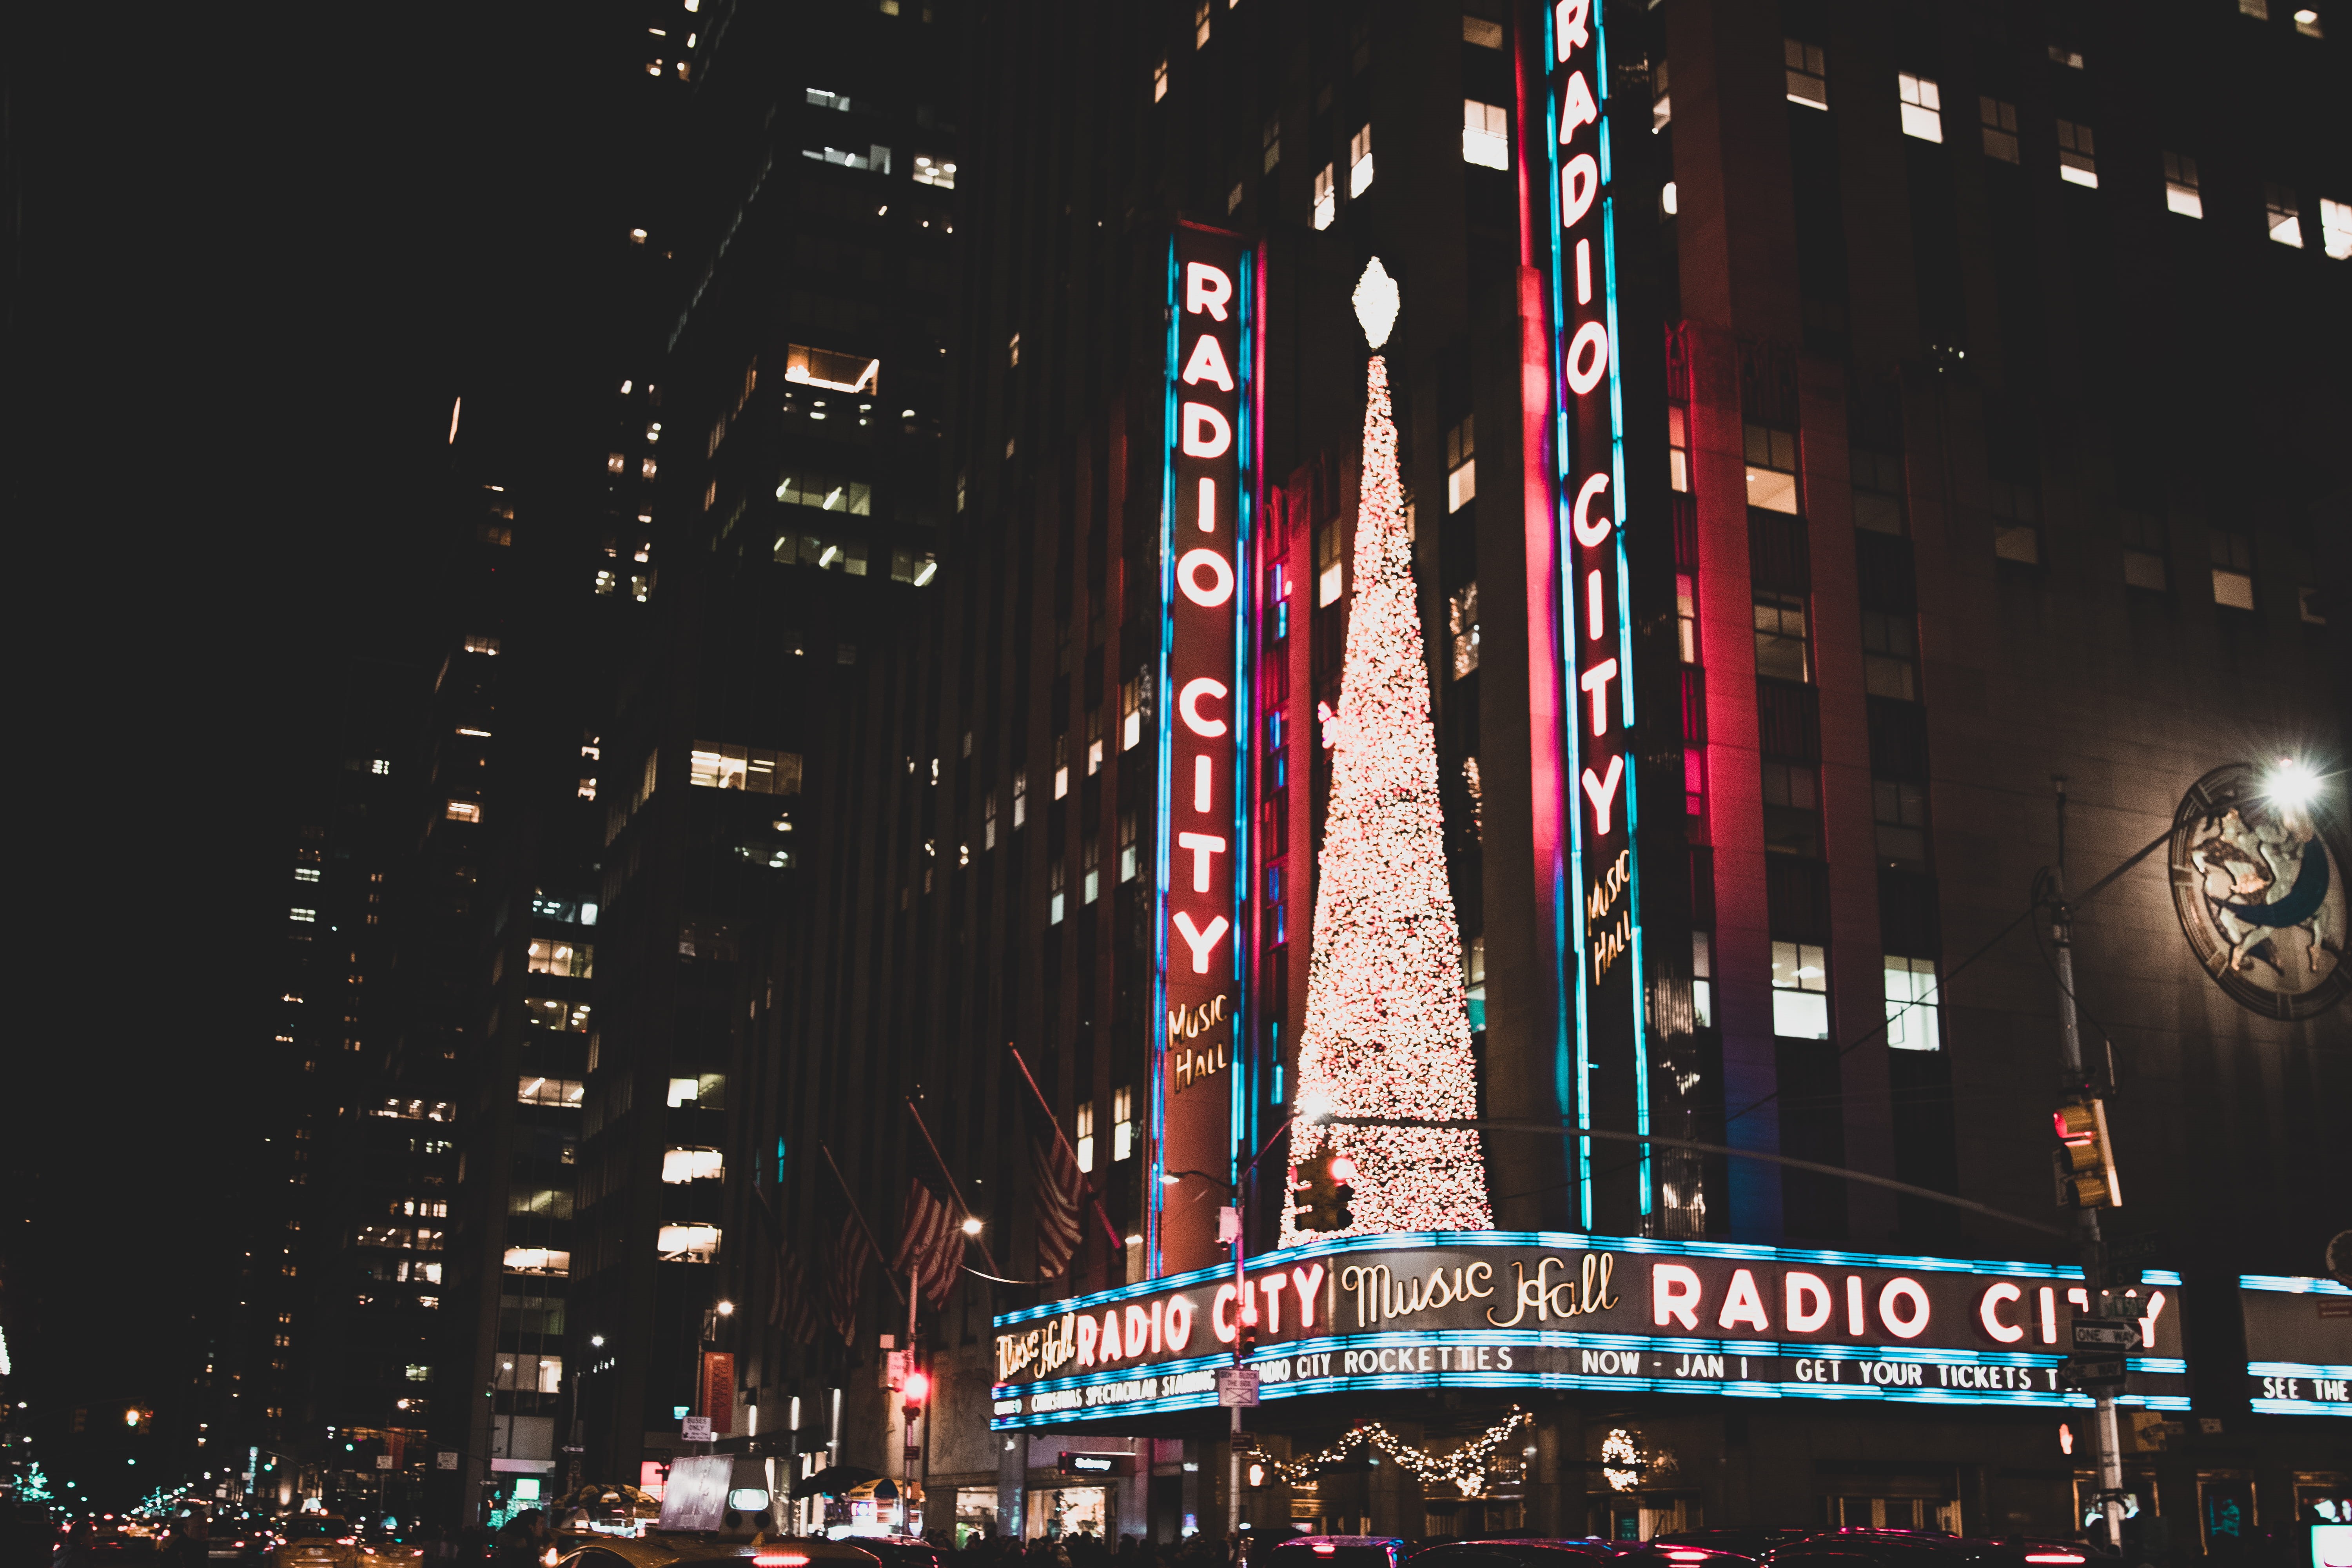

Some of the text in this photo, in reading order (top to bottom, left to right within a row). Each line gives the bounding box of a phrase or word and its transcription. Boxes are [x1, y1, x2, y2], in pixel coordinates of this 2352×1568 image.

[1555, 0, 1608, 394] RADIO
[1176, 261, 1234, 607] RADIO
[1573, 473, 1624, 836] CITY
[1172, 677, 1229, 975] CITY
[1594, 909, 1632, 986] HALL
[1176, 1043, 1227, 1094] HALL
[1341, 1252, 1619, 1328] Music Hall
[1653, 1263, 1931, 1339] RADIO
[1034, 1312, 1076, 1379] Hall
[1077, 1294, 1192, 1367] RADIO
[1296, 1353, 1331, 1379] CITY
[1344, 1347, 1513, 1374] ROCKETTES
[1582, 1350, 1640, 1375] NOW
[1675, 1354, 1724, 1379] JAN
[2078, 1328, 2136, 1343] ONE WAY
[1085, 1378, 1158, 1406] SPECTACULAR
[1795, 1358, 1842, 1383] GET
[1859, 1361, 1923, 1386] YOUR
[1936, 1364, 2032, 1390] TICKETS
[2263, 1377, 2350, 1401] SEE THE
